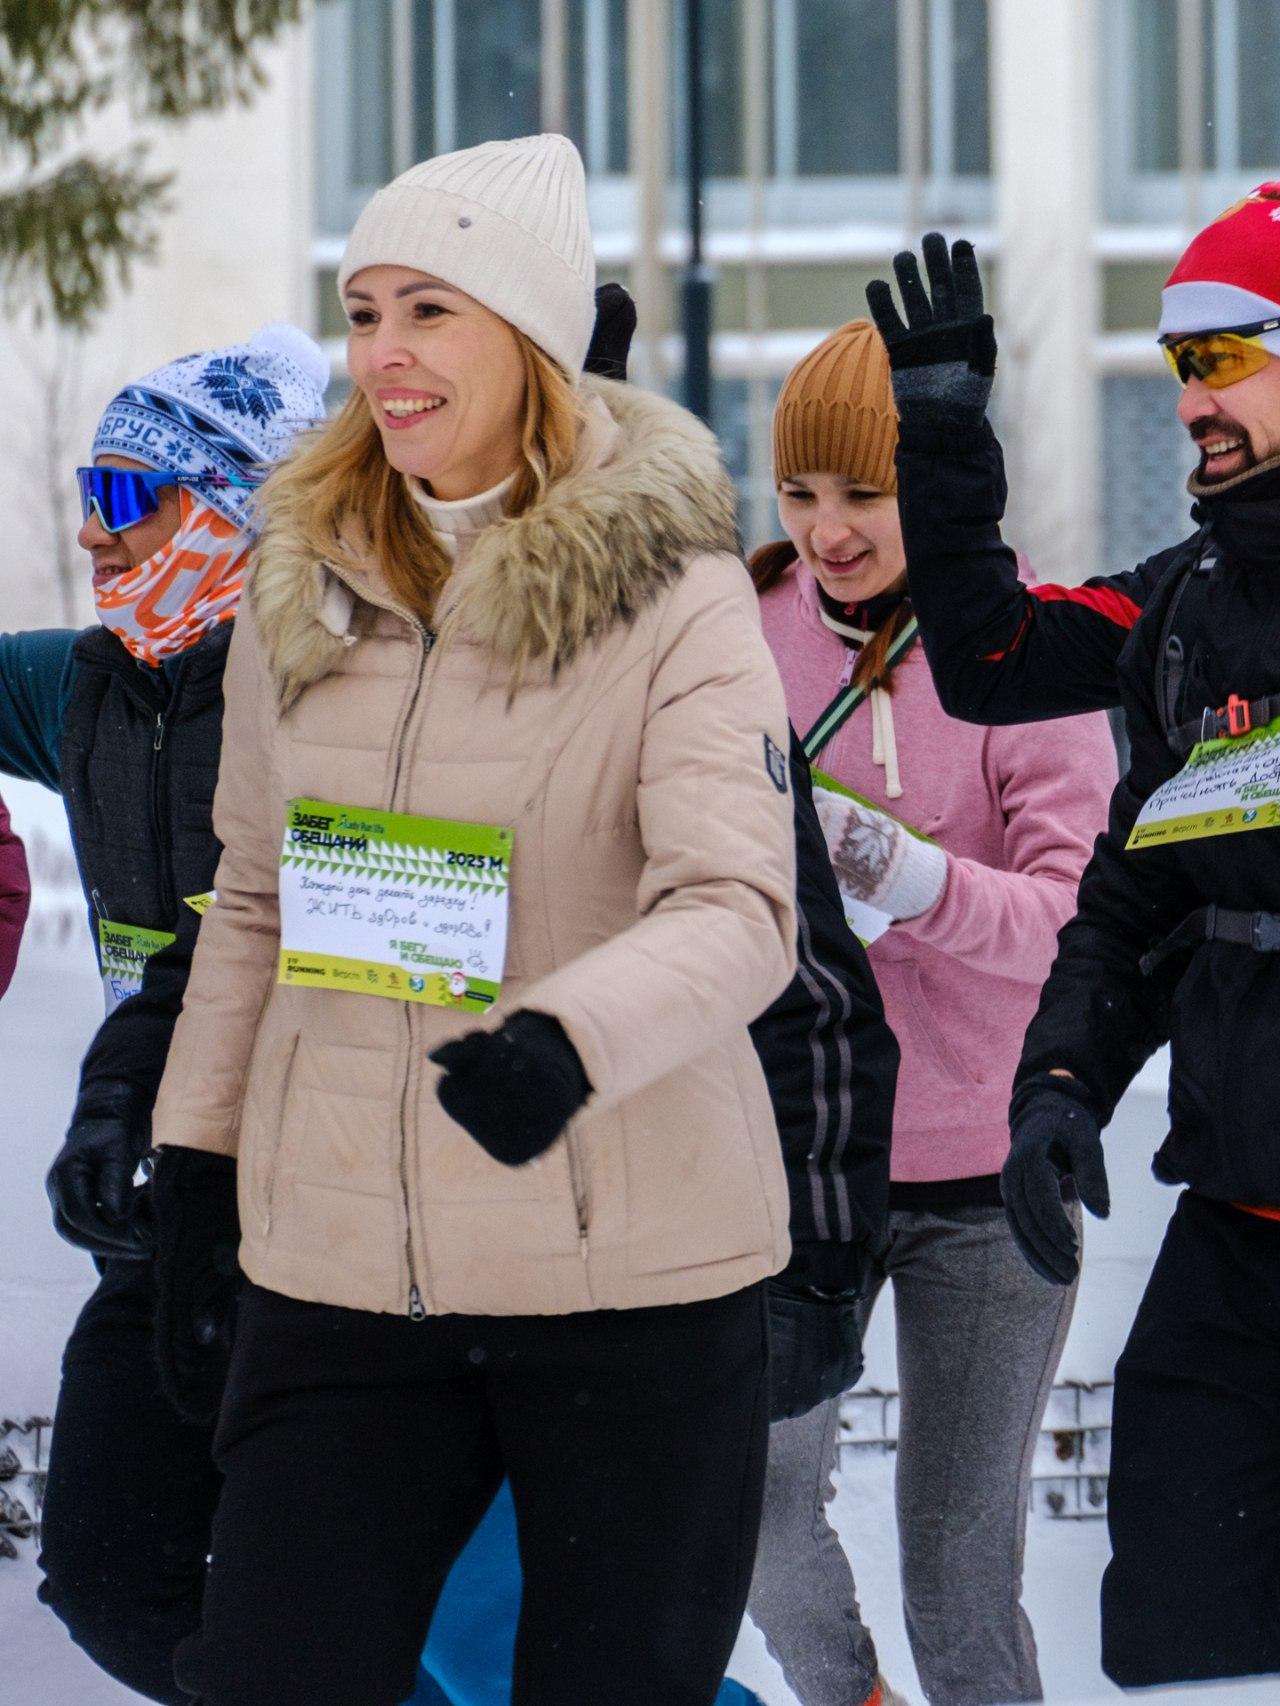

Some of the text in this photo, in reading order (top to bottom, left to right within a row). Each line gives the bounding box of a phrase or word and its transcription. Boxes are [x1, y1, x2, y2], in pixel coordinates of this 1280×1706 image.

[292, 812, 334, 830] ЗАБЕГ
[291, 828, 368, 852] ОБЕЩАНИЙ
[104, 932, 134, 947] ЗАБЕГ
[389, 939, 428, 952] Я БЕГУ
[400, 952, 463, 968] И ОБЕЩАЮ
